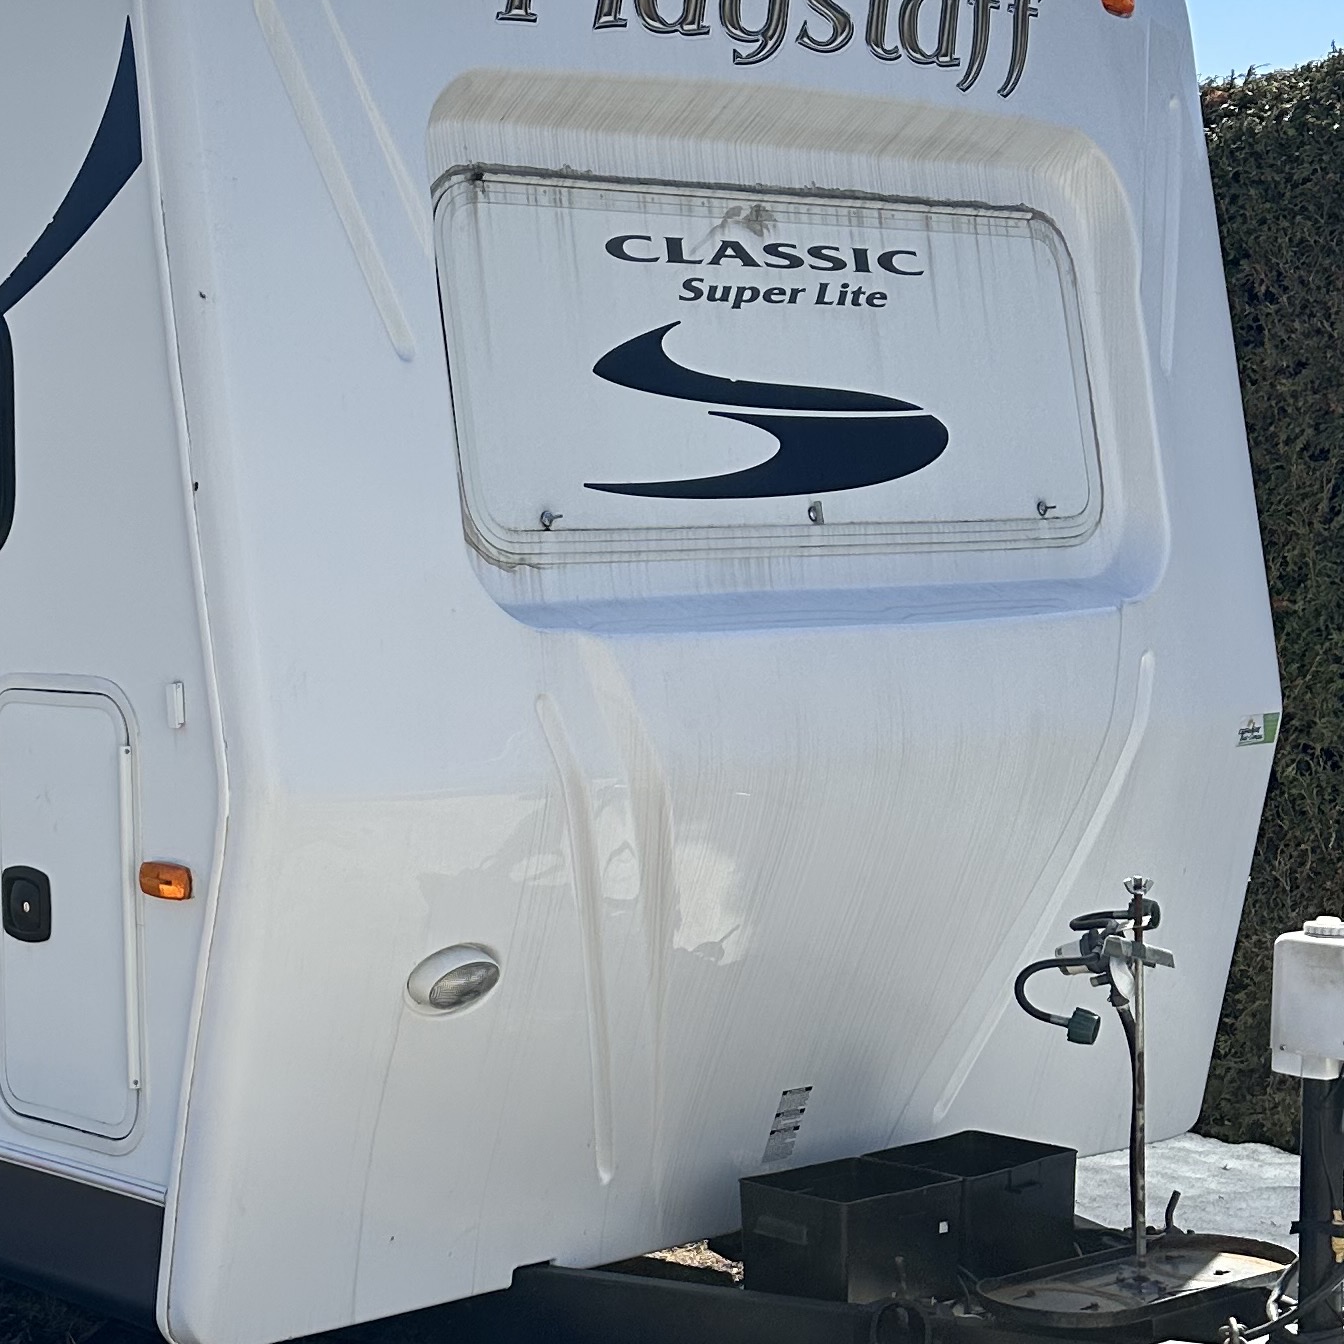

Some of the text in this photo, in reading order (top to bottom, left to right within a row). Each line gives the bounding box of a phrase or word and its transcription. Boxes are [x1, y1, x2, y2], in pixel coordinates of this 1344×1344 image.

[605, 234, 924, 276] CLASSIC
[678, 277, 888, 309] Super Lite
